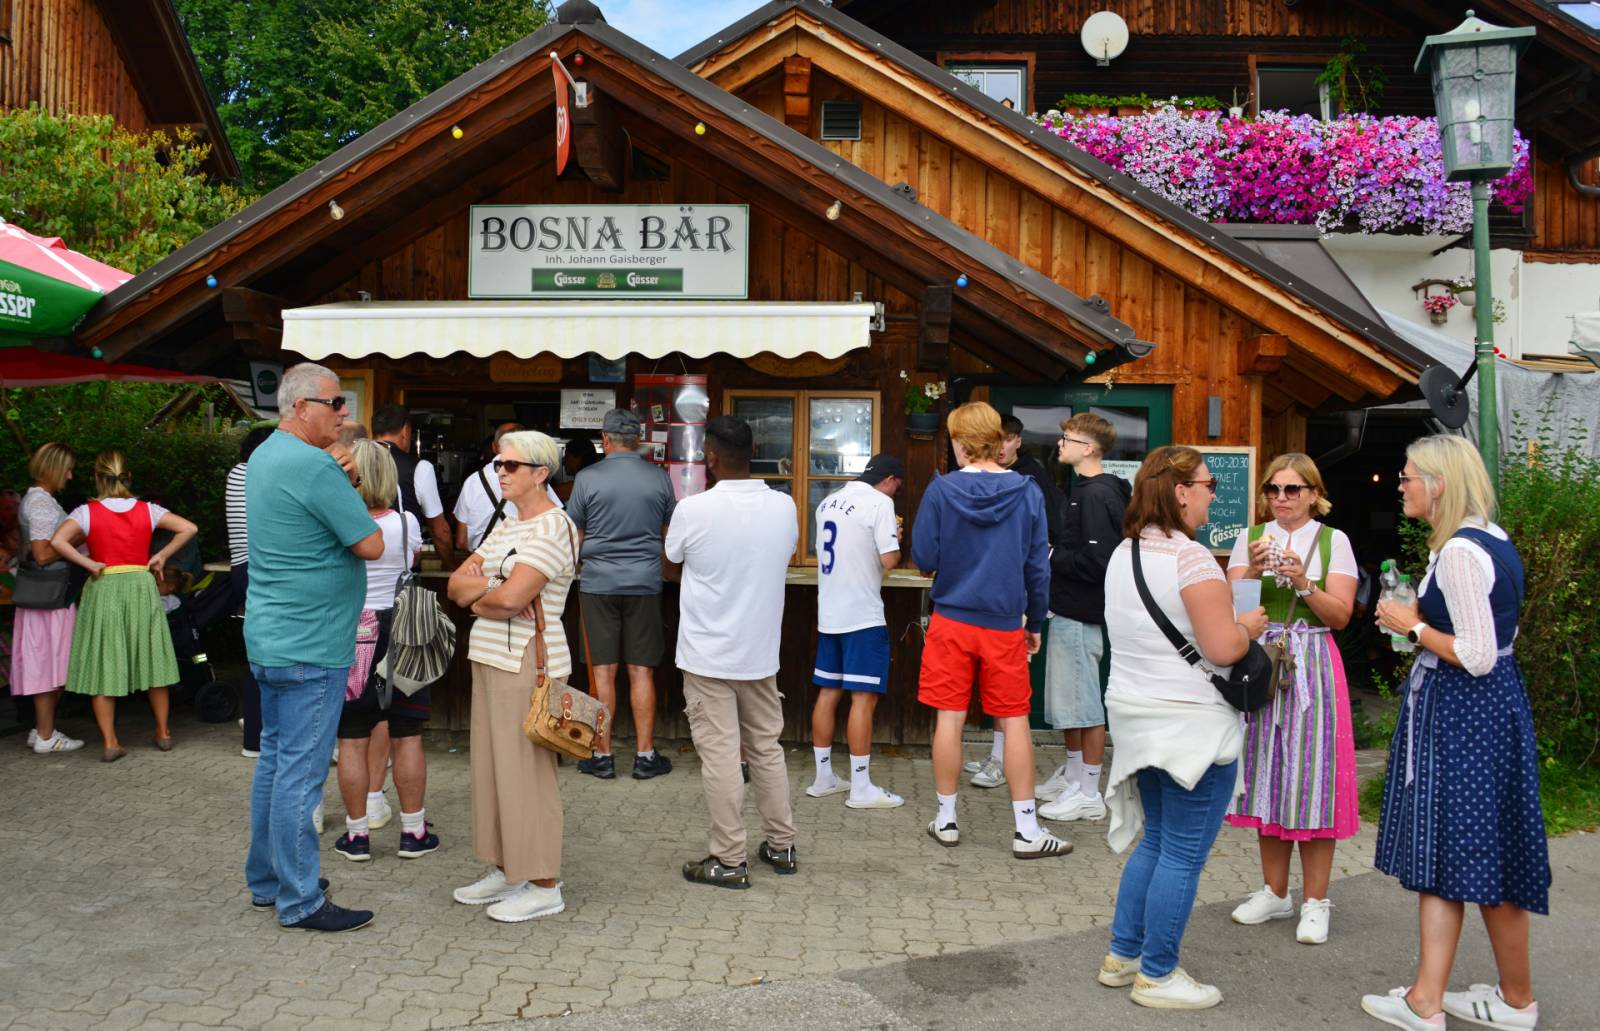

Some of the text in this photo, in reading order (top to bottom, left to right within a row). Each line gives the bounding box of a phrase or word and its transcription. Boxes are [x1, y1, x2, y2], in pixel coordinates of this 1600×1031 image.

[480, 206, 736, 252] BOSNA BÄR
[545, 254, 668, 266] Inh. Johann Gaisberger
[554, 272, 659, 287] Gösser Gösser
[0, 291, 36, 319] sser
[820, 499, 856, 516] BALE
[1210, 528, 1241, 547] Gösse
[822, 520, 838, 576] 3
